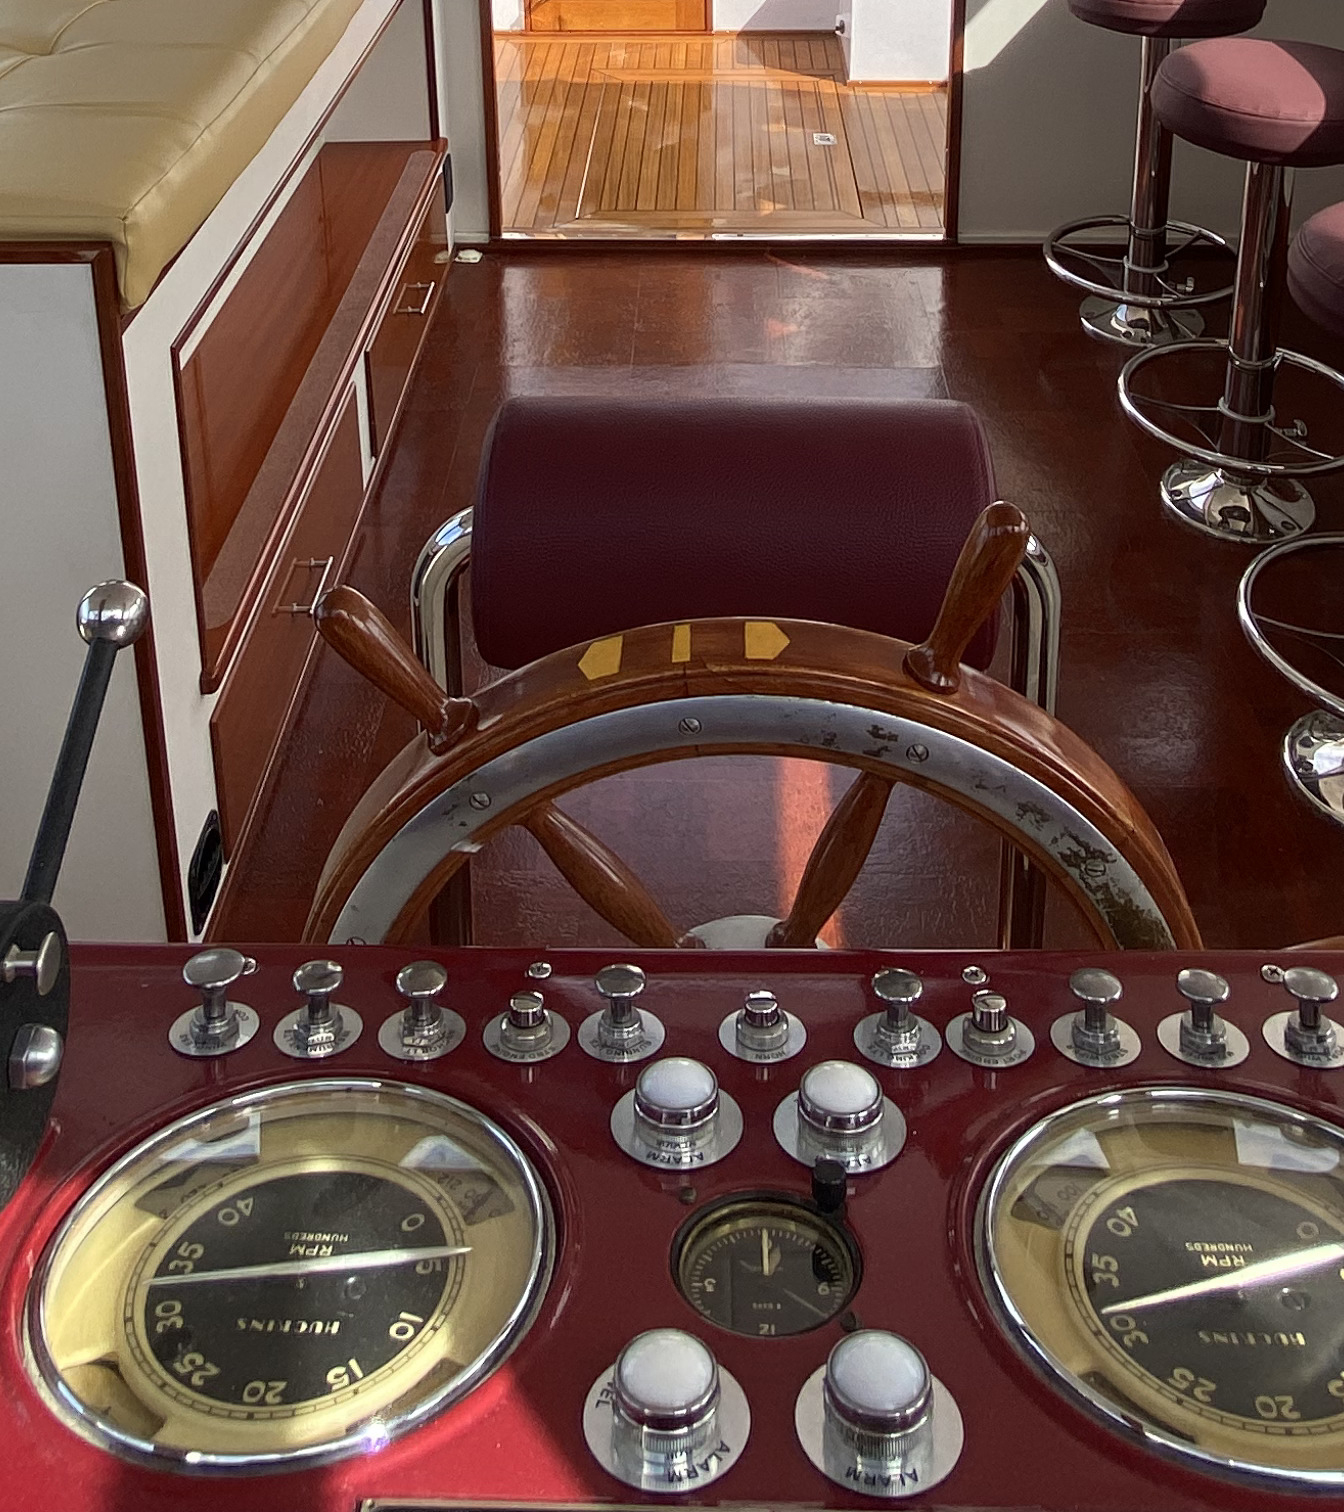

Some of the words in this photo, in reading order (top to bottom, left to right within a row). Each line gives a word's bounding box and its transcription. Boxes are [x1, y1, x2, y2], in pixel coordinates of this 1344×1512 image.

[754, 1050, 786, 1061] HORN
[645, 1150, 705, 1164] ALARM
[218, 1196, 254, 1228] 40
[401, 1213, 426, 1233] 0
[1105, 1204, 1140, 1237] 40
[283, 1231, 349, 1243] HUNDREDS
[1296, 1221, 1320, 1240] 0
[168, 1240, 205, 1275] 35
[289, 1242, 334, 1257] RPM
[1185, 1241, 1253, 1253] HUNDREDS
[416, 1258, 443, 1276] 5
[1091, 1252, 1120, 1288] 35
[1200, 1253, 1246, 1267] RPM
[703, 1278, 717, 1292] 3
[817, 1282, 831, 1296] 9
[155, 1299, 184, 1335] 30
[236, 1316, 342, 1335] HUCKINS
[388, 1310, 425, 1342] 10
[758, 1323, 777, 1336] 12
[1109, 1314, 1149, 1348] 30
[172, 1351, 222, 1386] 25
[325, 1357, 365, 1392] 15
[242, 1380, 289, 1405] 20
[1167, 1367, 1217, 1402] 25
[1255, 1395, 1301, 1420] 20
[667, 1439, 731, 1484] ALARM
[844, 1465, 919, 1487] ALARM
